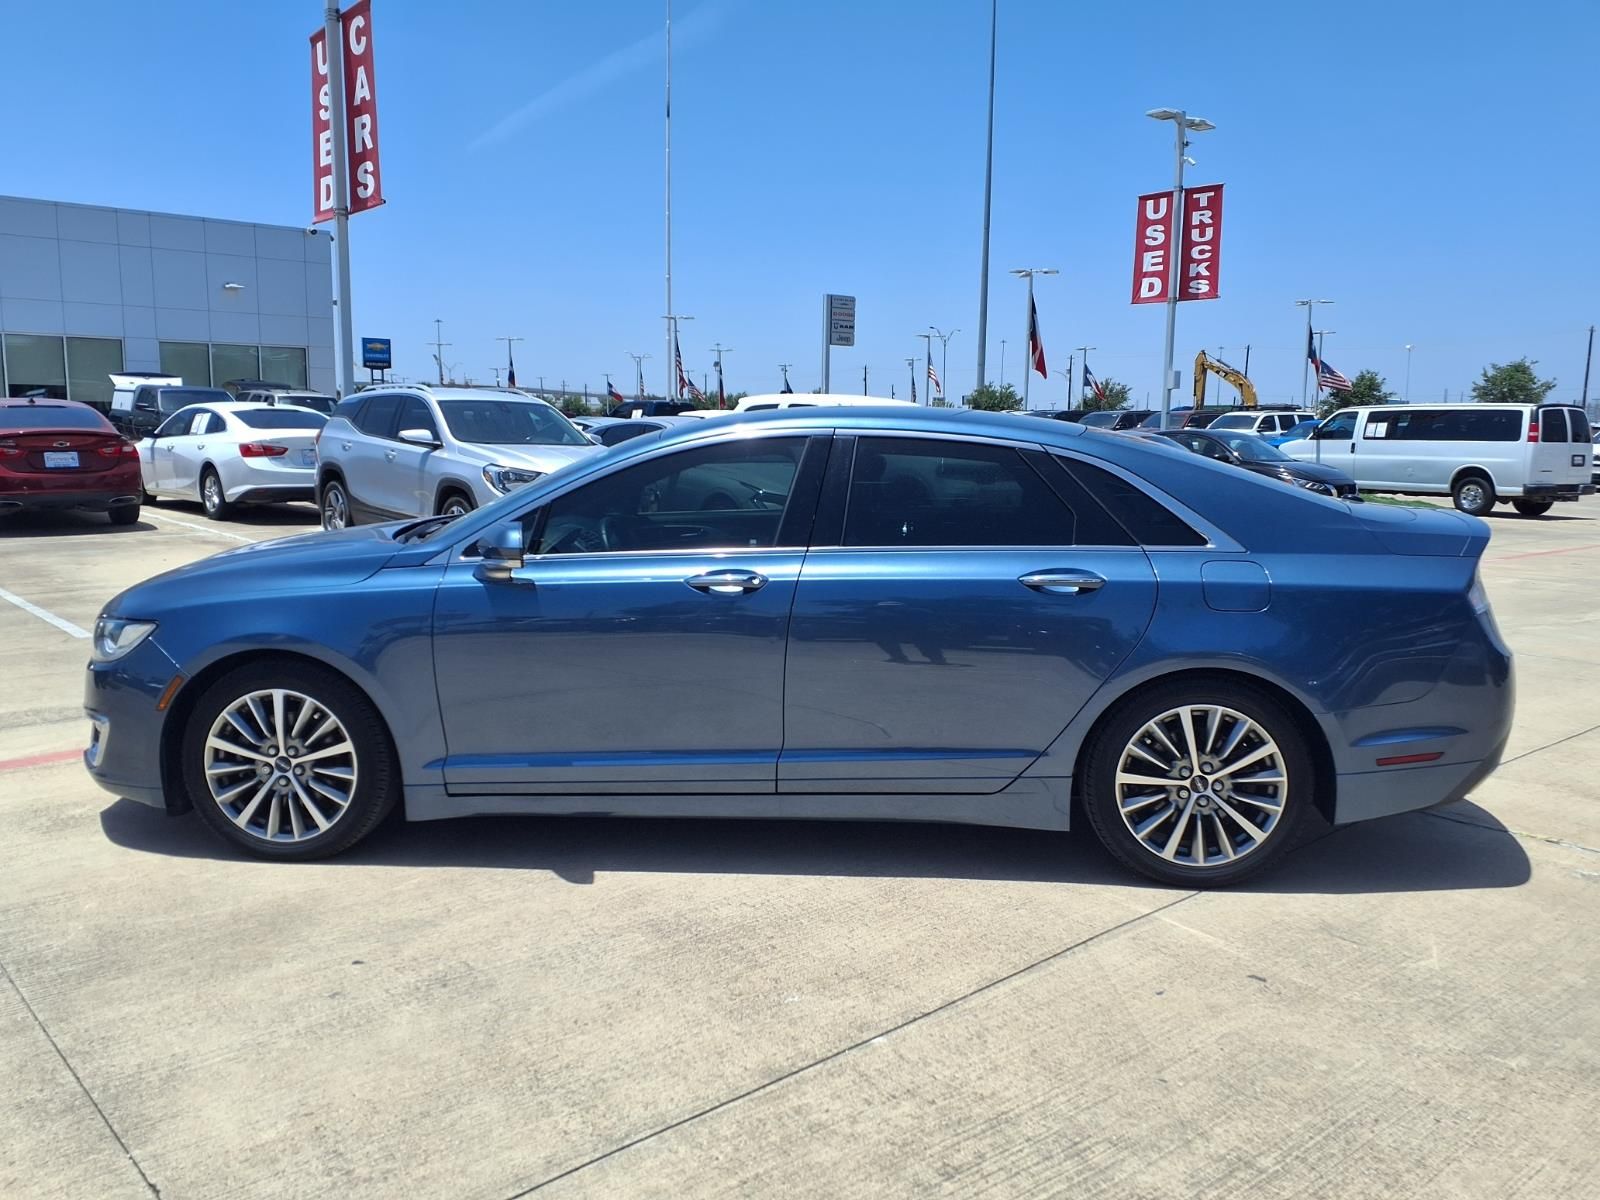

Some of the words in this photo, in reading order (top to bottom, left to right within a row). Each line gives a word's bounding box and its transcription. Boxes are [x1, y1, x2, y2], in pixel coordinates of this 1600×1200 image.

[349, 14, 375, 199] CARS
[1140, 198, 1168, 298] USED
[1188, 191, 1215, 294] TRUCKS
